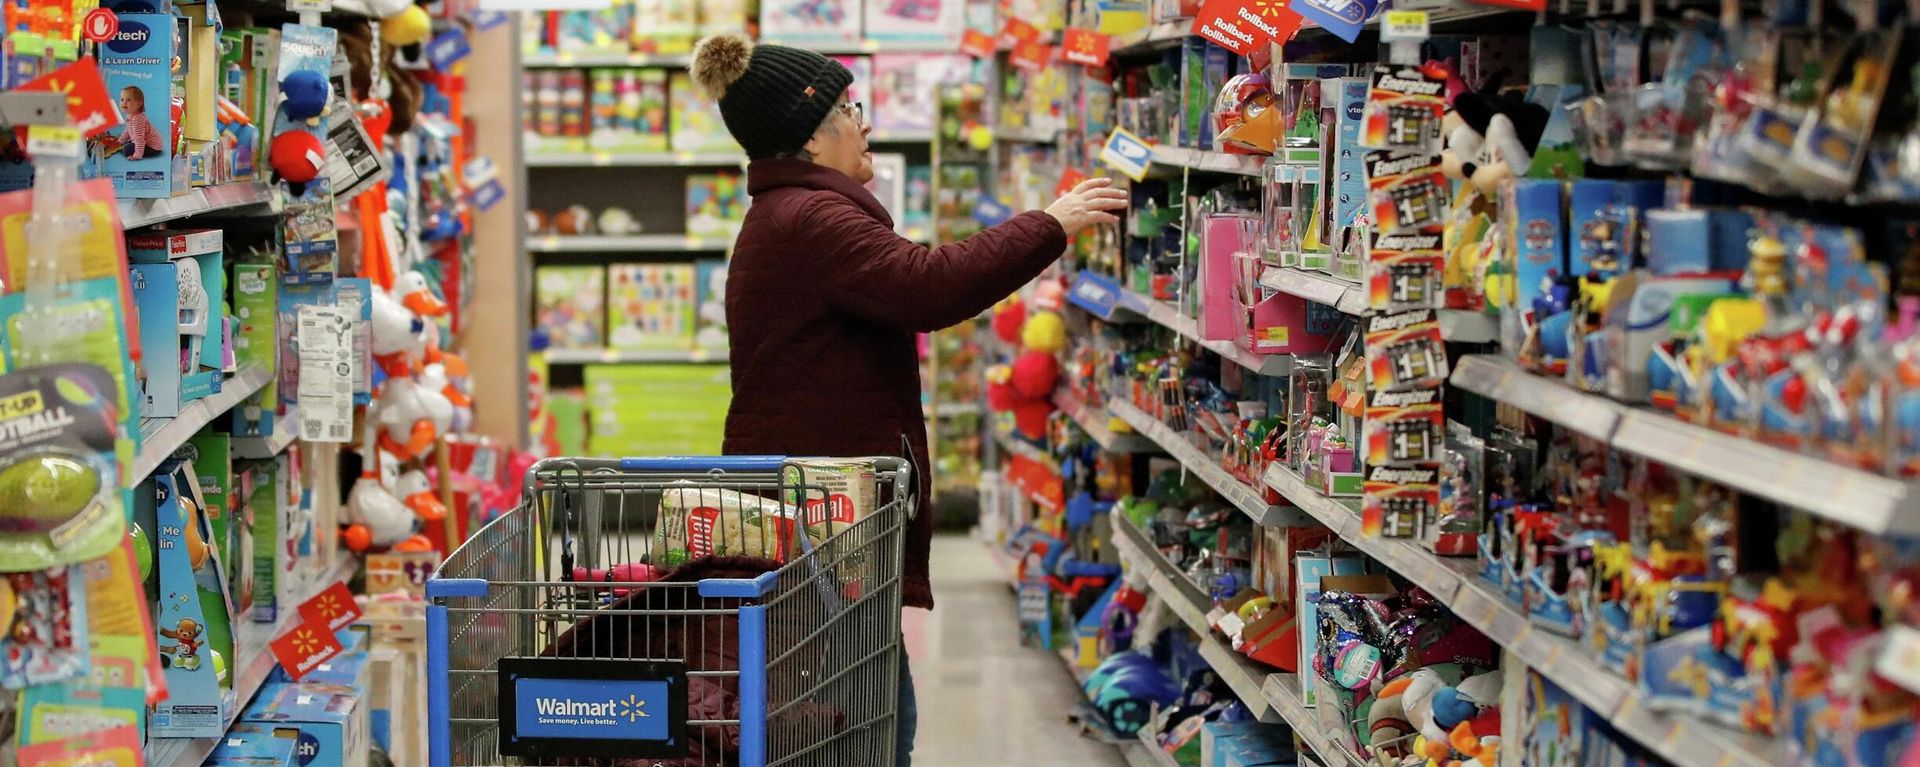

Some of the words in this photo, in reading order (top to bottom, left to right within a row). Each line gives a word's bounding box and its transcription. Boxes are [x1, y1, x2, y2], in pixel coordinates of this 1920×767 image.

[1213, 16, 1254, 46] Rollback
[1237, 6, 1279, 39] Rollback
[1200, 24, 1241, 50] Rollback
[1311, 310, 1341, 319] TAC
[163, 526, 179, 536] Me
[297, 645, 335, 673] Rollback
[1453, 655, 1484, 665] Series
[536, 697, 617, 717] Walmart
[538, 717, 555, 725] Save
[555, 718, 579, 726] money.
[580, 717, 595, 725] Live
